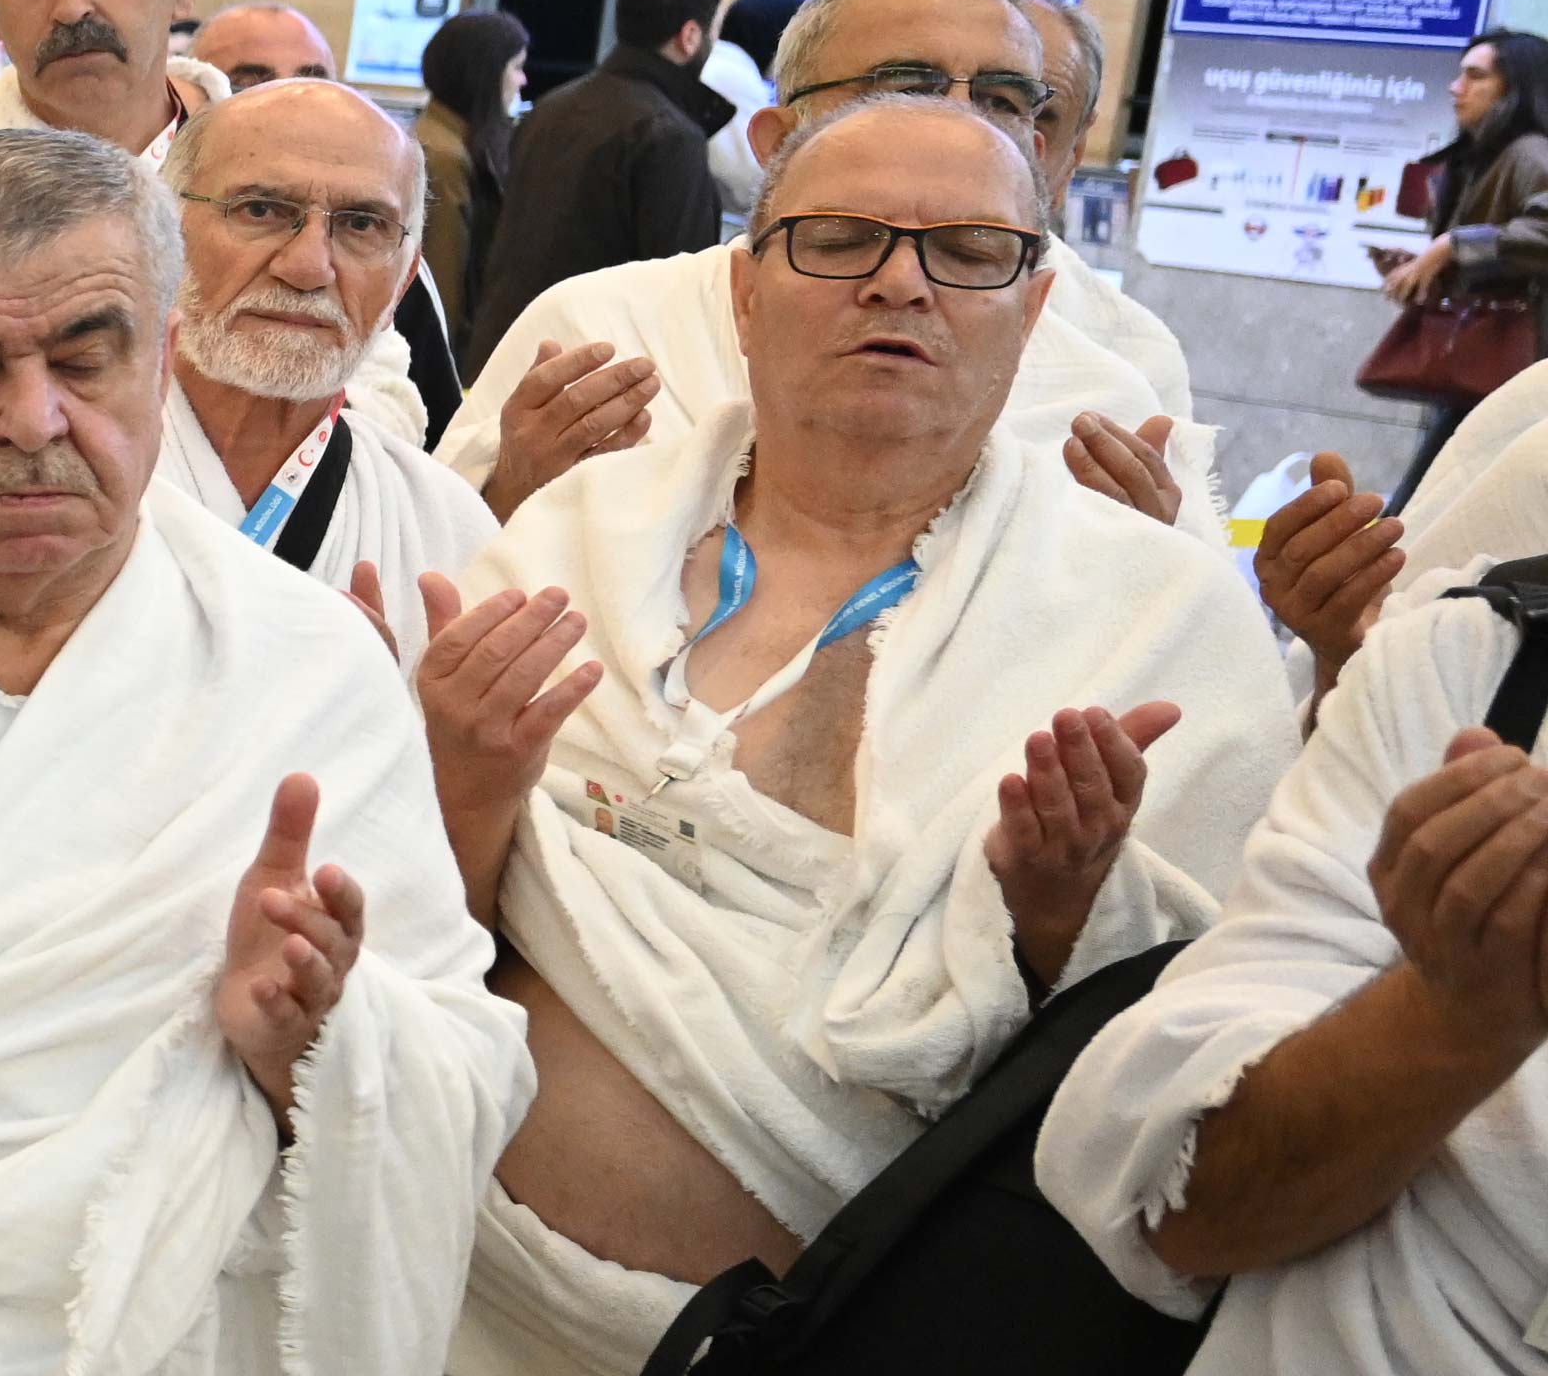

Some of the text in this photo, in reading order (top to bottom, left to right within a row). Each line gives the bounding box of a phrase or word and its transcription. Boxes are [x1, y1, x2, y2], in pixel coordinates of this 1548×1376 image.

[1203, 68, 1427, 105] uçuş güvenliğiniz için
